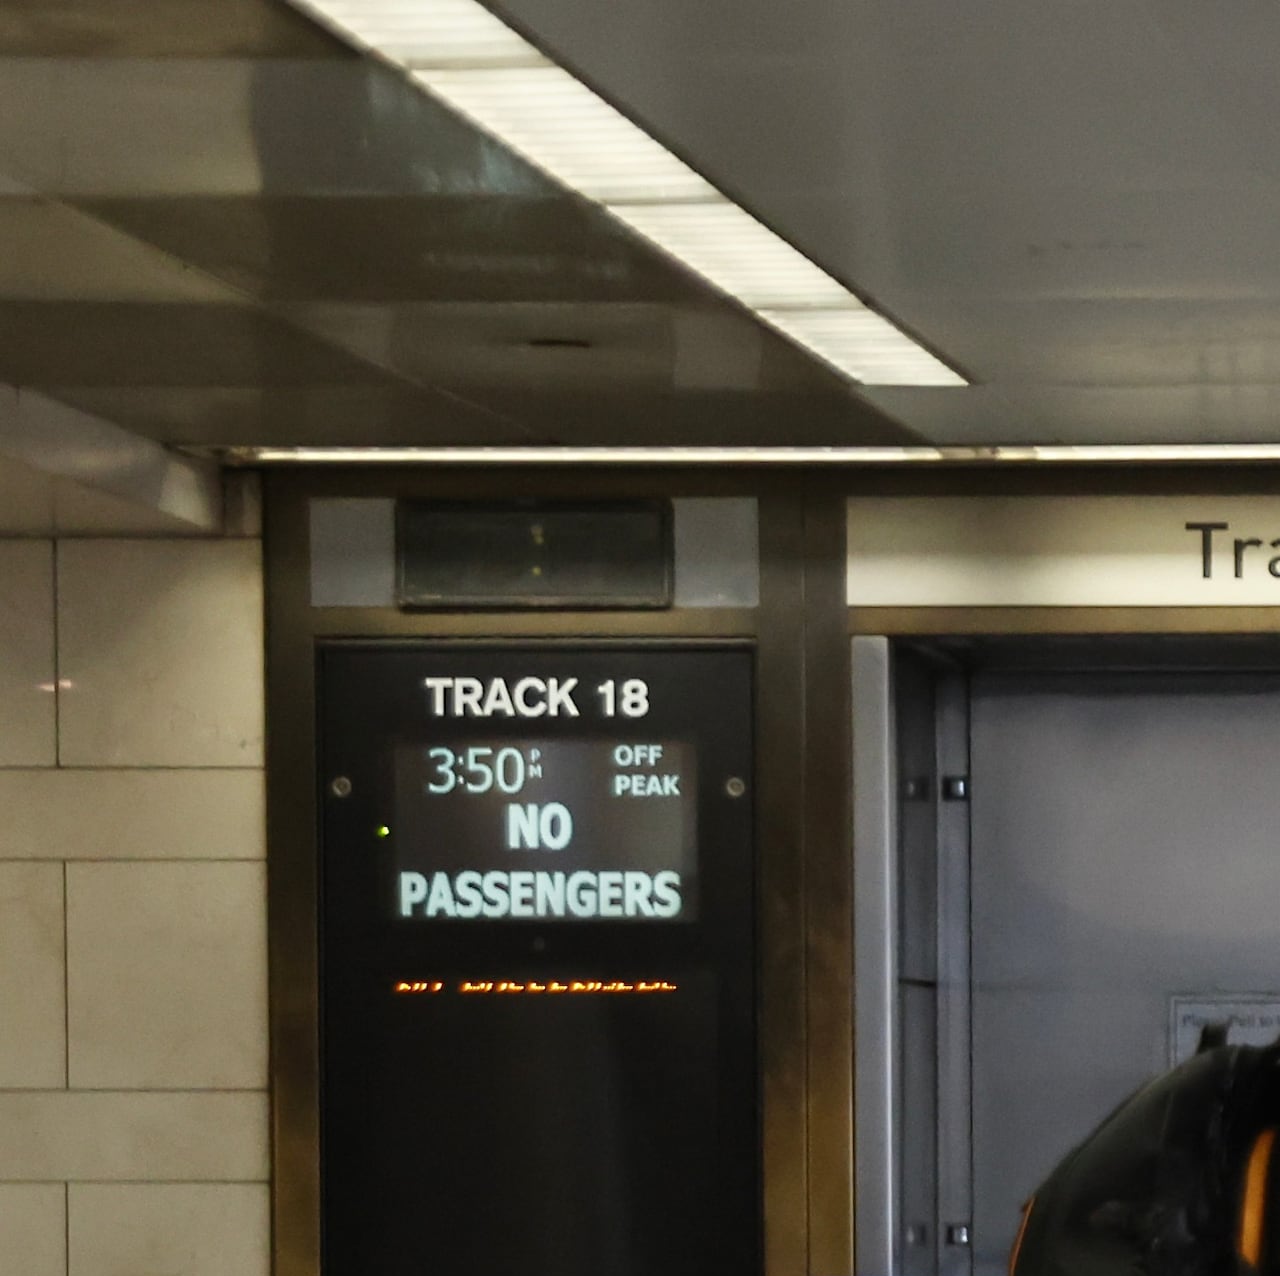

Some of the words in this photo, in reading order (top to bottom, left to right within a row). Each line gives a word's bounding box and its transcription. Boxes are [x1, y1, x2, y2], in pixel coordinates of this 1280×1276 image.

[425, 677, 580, 717] TRACK
[597, 679, 650, 717] 18
[428, 747, 525, 794] 3:50
[613, 744, 664, 766] OFF
[613, 774, 680, 796] PEAK
[507, 801, 573, 850] NO
[399, 870, 682, 917] PASSENGERS
